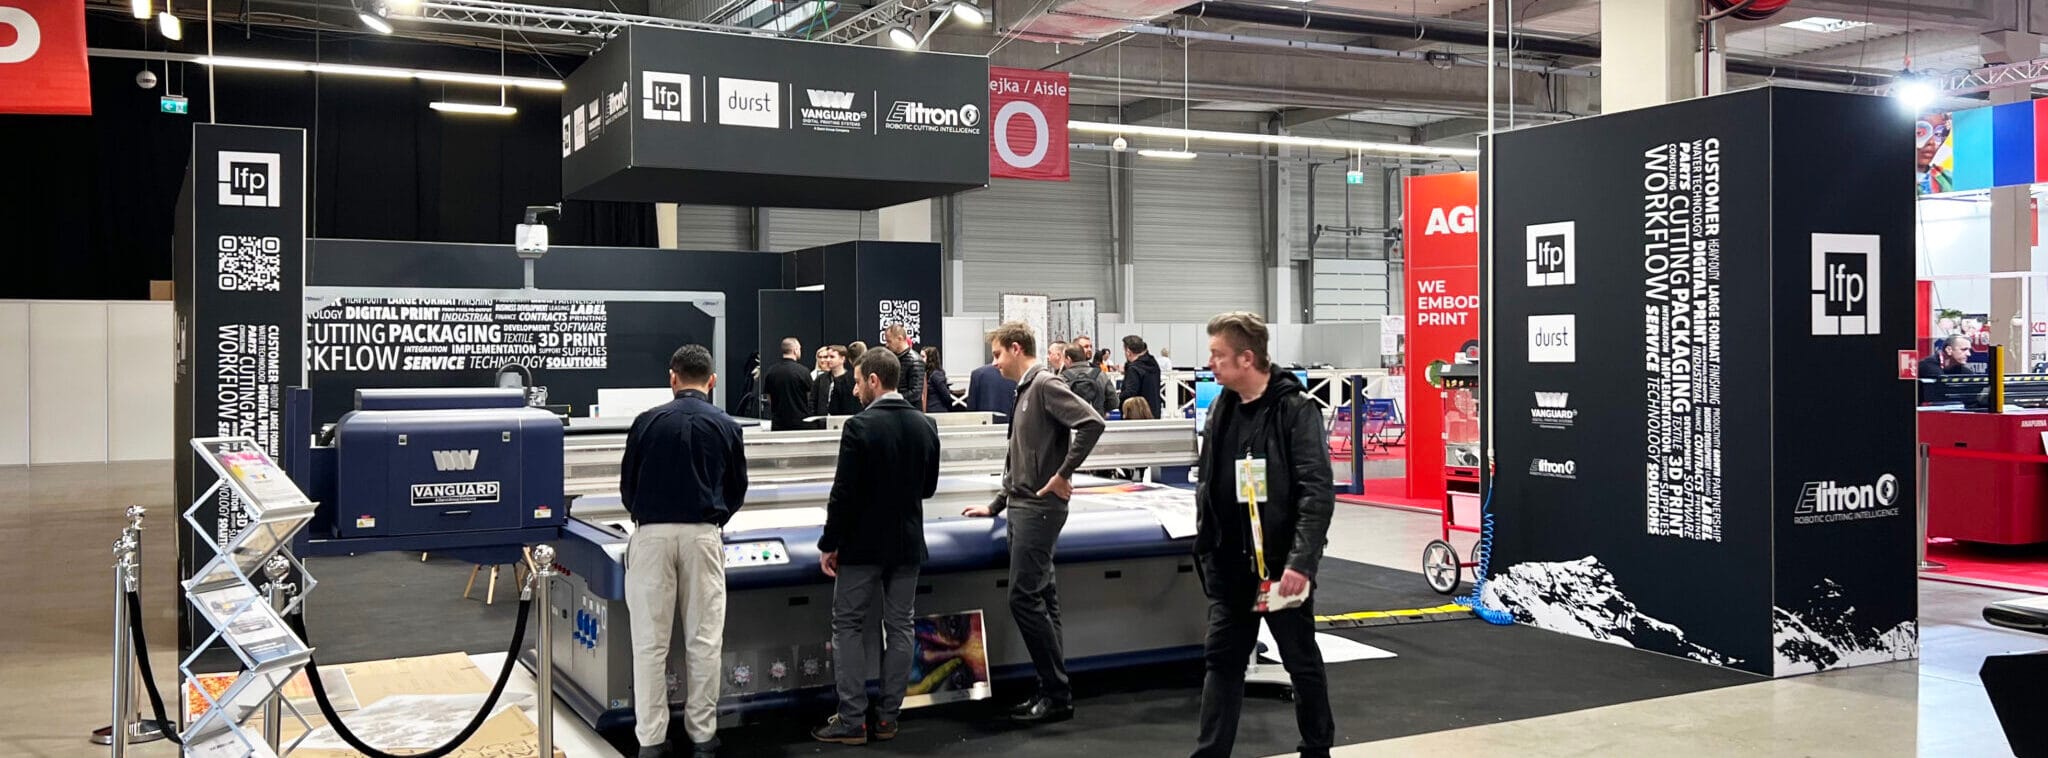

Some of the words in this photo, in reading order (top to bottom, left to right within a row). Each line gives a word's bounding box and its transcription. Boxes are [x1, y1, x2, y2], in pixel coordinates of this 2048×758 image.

[655, 85, 679, 110] lfp
[728, 90, 771, 112] durst
[1024, 79, 1030, 94] /
[1033, 82, 1067, 96] Aisle
[800, 108, 861, 122] VANGUARD
[885, 101, 958, 126] Elitron
[913, 124, 939, 132] CUTTING
[940, 126, 980, 134] INTELLIGENCE
[994, 100, 1049, 168] O
[1669, 143, 1677, 191] CONSULTING
[1679, 142, 1691, 191] PARTS
[1692, 139, 1702, 173] WATER
[234, 167, 265, 194] lfp
[1705, 138, 1719, 236] CUSTOMER
[1425, 206, 1479, 235] AG
[1644, 144, 1669, 301] WORKFLOW
[1692, 174, 1703, 238] TECHNOLOGY
[1538, 241, 1563, 271] lfp
[1669, 195, 1690, 285] CUTTING
[1693, 240, 1706, 298] DIGITAL
[1708, 239, 1720, 280] HEAVY-DUTY
[1417, 296, 1479, 309] EMBOD
[1418, 280, 1446, 293] WE
[1708, 285, 1720, 318] LARGE
[1829, 263, 1864, 312] lfp
[346, 306, 399, 320] DIGITAL
[402, 307, 440, 320] PRINT
[441, 312, 493, 322] INDUSTRIAL
[569, 304, 607, 315] LABEL
[518, 312, 567, 321] CONTRACTS
[1417, 312, 1468, 326] PRINT
[1693, 300, 1707, 344] PRINT
[248, 325, 257, 355] PARTS
[258, 325, 266, 345] WATER
[389, 324, 501, 343] PACKAGING
[503, 324, 551, 332] DEVELOPMENT
[553, 322, 607, 332] SOFTWARE
[503, 333, 534, 343] TEXTILE
[538, 333, 560, 347] 3D
[563, 333, 607, 347] PRINT
[1536, 327, 1568, 347] durst
[1645, 304, 1660, 372] SERVICE
[1708, 320, 1720, 363] FORMAT
[258, 345, 266, 383] TECHNOLOGY
[268, 325, 279, 383] CUSTOMER
[402, 356, 466, 370] SERVICE
[546, 356, 607, 369] SOLUTIONS
[404, 345, 448, 353] INTEGRATION
[452, 344, 537, 354] IMPLEMENTATION
[562, 347, 607, 357] SUPPLIES
[1671, 289, 1691, 413] PACKAGING
[218, 324, 239, 420] WORKFLOW
[239, 356, 256, 411] CUTTING
[1692, 346, 1702, 404] INDUSTRIAL
[1709, 364, 1720, 405] FINISHING
[258, 384, 269, 418] DIGITAL
[1531, 408, 1573, 419] VANGUARD
[1661, 357, 1671, 453] IMPLEMENTATION
[258, 419, 269, 446] PRINT
[270, 410, 279, 430] LARGE
[1647, 377, 1660, 464] TECHNOLOGY
[1672, 416, 1683, 451] TEXTILE
[270, 430, 279, 457] FORMAT
[1683, 416, 1692, 471] DEVELOPMENT
[1668, 455, 1683, 480] 3D
[1694, 434, 1704, 493] CONTRACTS
[414, 484, 497, 497] VANGUARD
[1647, 462, 1660, 535] SOLUTIONS
[1683, 473, 1694, 539] SOFTWARE
[1794, 481, 1874, 514] Elitron
[236, 511, 248, 527] 3D
[1660, 482, 1669, 536] SUPPLIES
[1669, 485, 1683, 538] PRINT
[1701, 496, 1713, 541] LABEL
[1712, 477, 1721, 542] PARTNERSHIP
[1793, 515, 1825, 524] ROBOTIC
[1824, 513, 1853, 522] CUTTING
[1854, 507, 1899, 519] INTELLIGENCE
